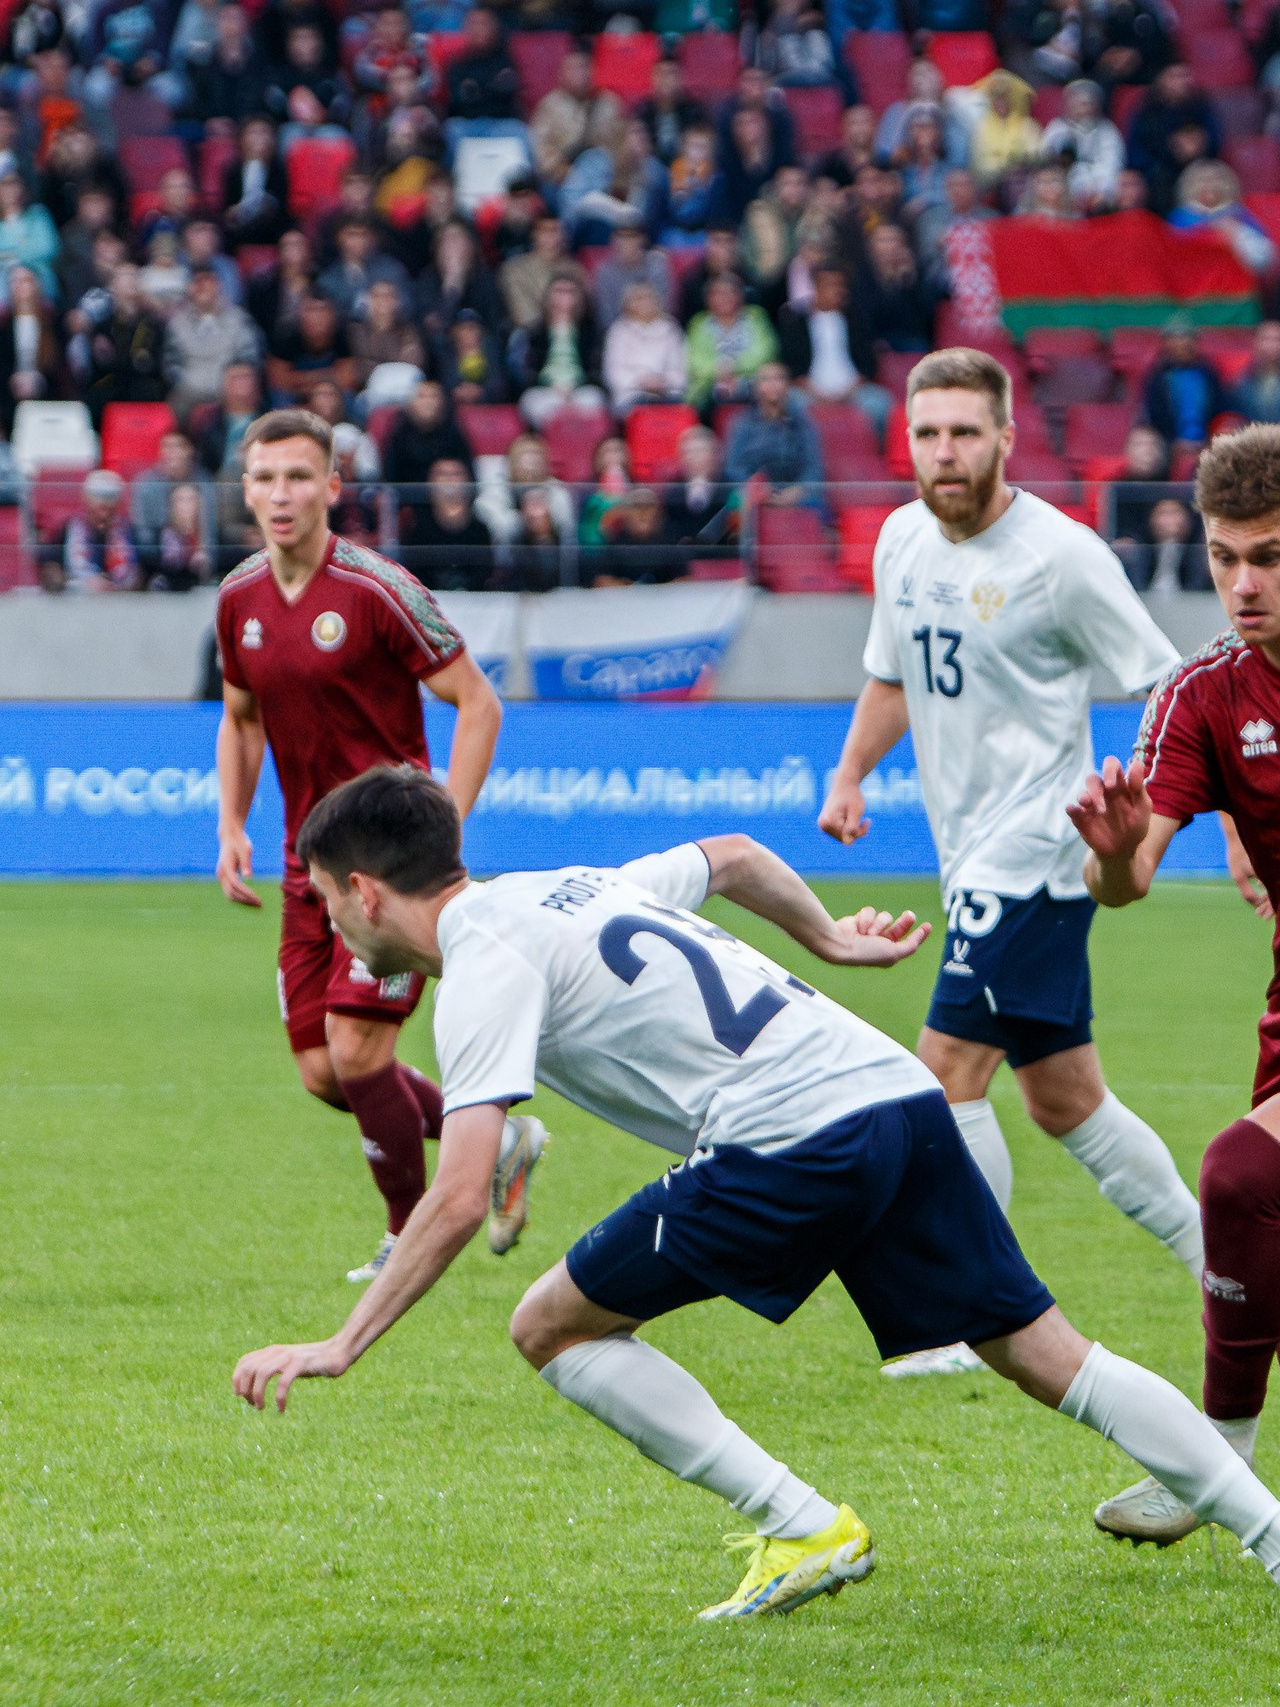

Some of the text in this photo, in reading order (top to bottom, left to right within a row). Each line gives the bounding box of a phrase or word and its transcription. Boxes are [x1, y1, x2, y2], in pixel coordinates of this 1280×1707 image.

[911, 623, 964, 698] 13
[431, 755, 816, 818] ИЦИАЛЬНЫЙ
[598, 901, 815, 1057] 2
